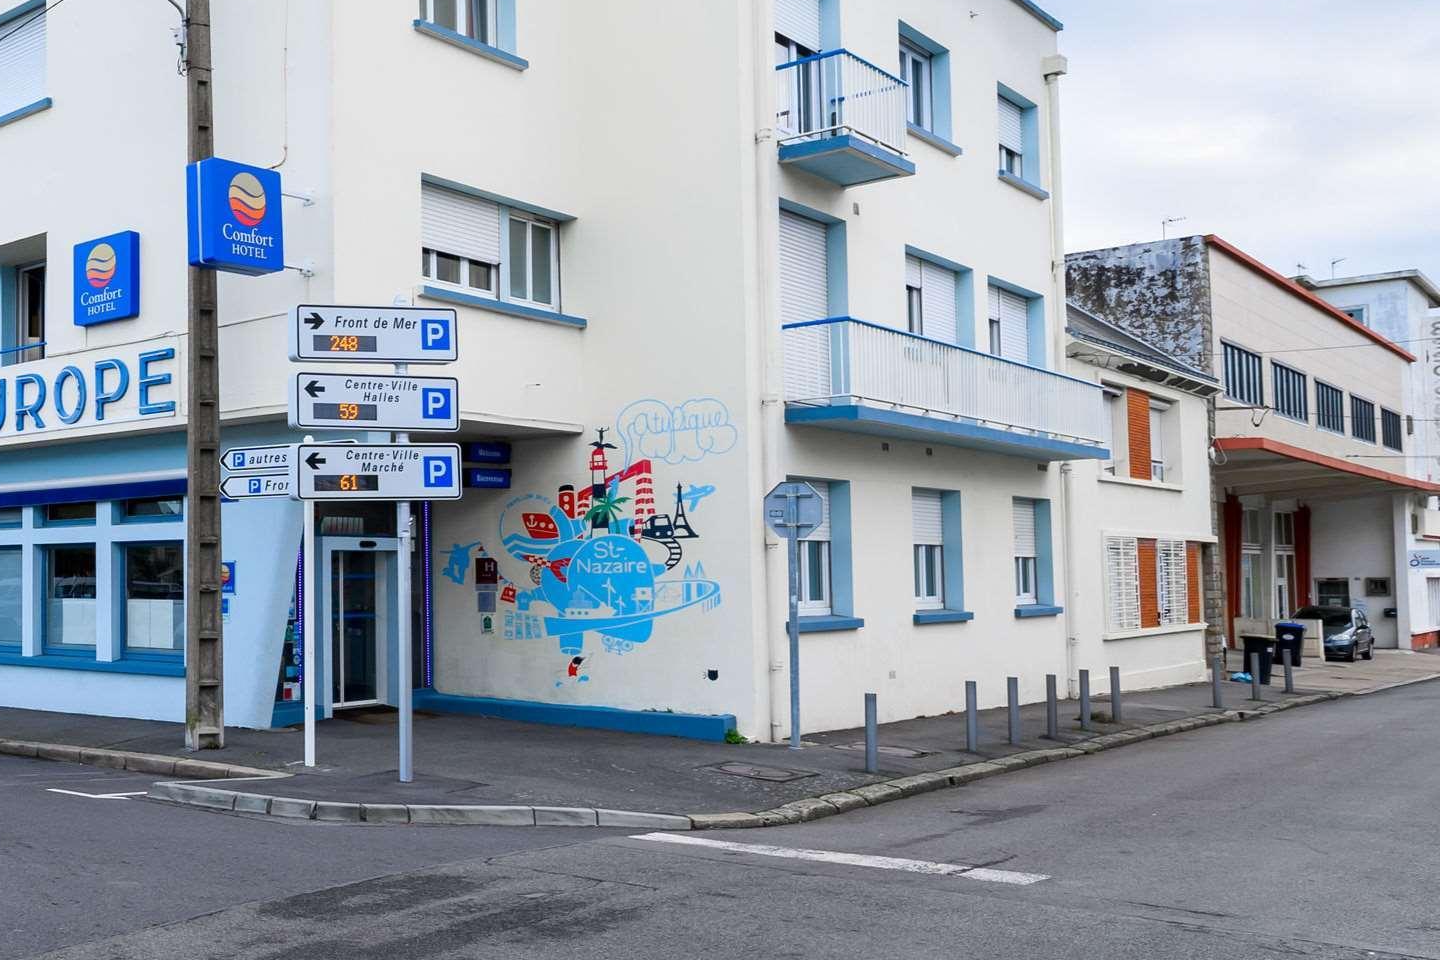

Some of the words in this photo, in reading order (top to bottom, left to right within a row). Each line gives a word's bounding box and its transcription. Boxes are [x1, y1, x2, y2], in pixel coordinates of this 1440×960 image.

[222, 223, 274, 248] Comfort
[232, 243, 267, 259] HOTEL
[80, 286, 123, 306] Comfort
[87, 300, 117, 317] HOTEL
[334, 315, 368, 329] Front
[373, 317, 388, 329] de
[392, 317, 417, 330] Mer
[329, 335, 359, 352] 248
[344, 378, 418, 391] Centre-Ville
[362, 391, 400, 403] Halles
[338, 403, 359, 420] 59
[248, 454, 287, 465] autres
[345, 449, 420, 461] Centre-Ville
[361, 461, 405, 473] Marché
[339, 474, 358, 491] 61
[593, 540, 626, 559] St-
[576, 556, 647, 574] Nazaire
